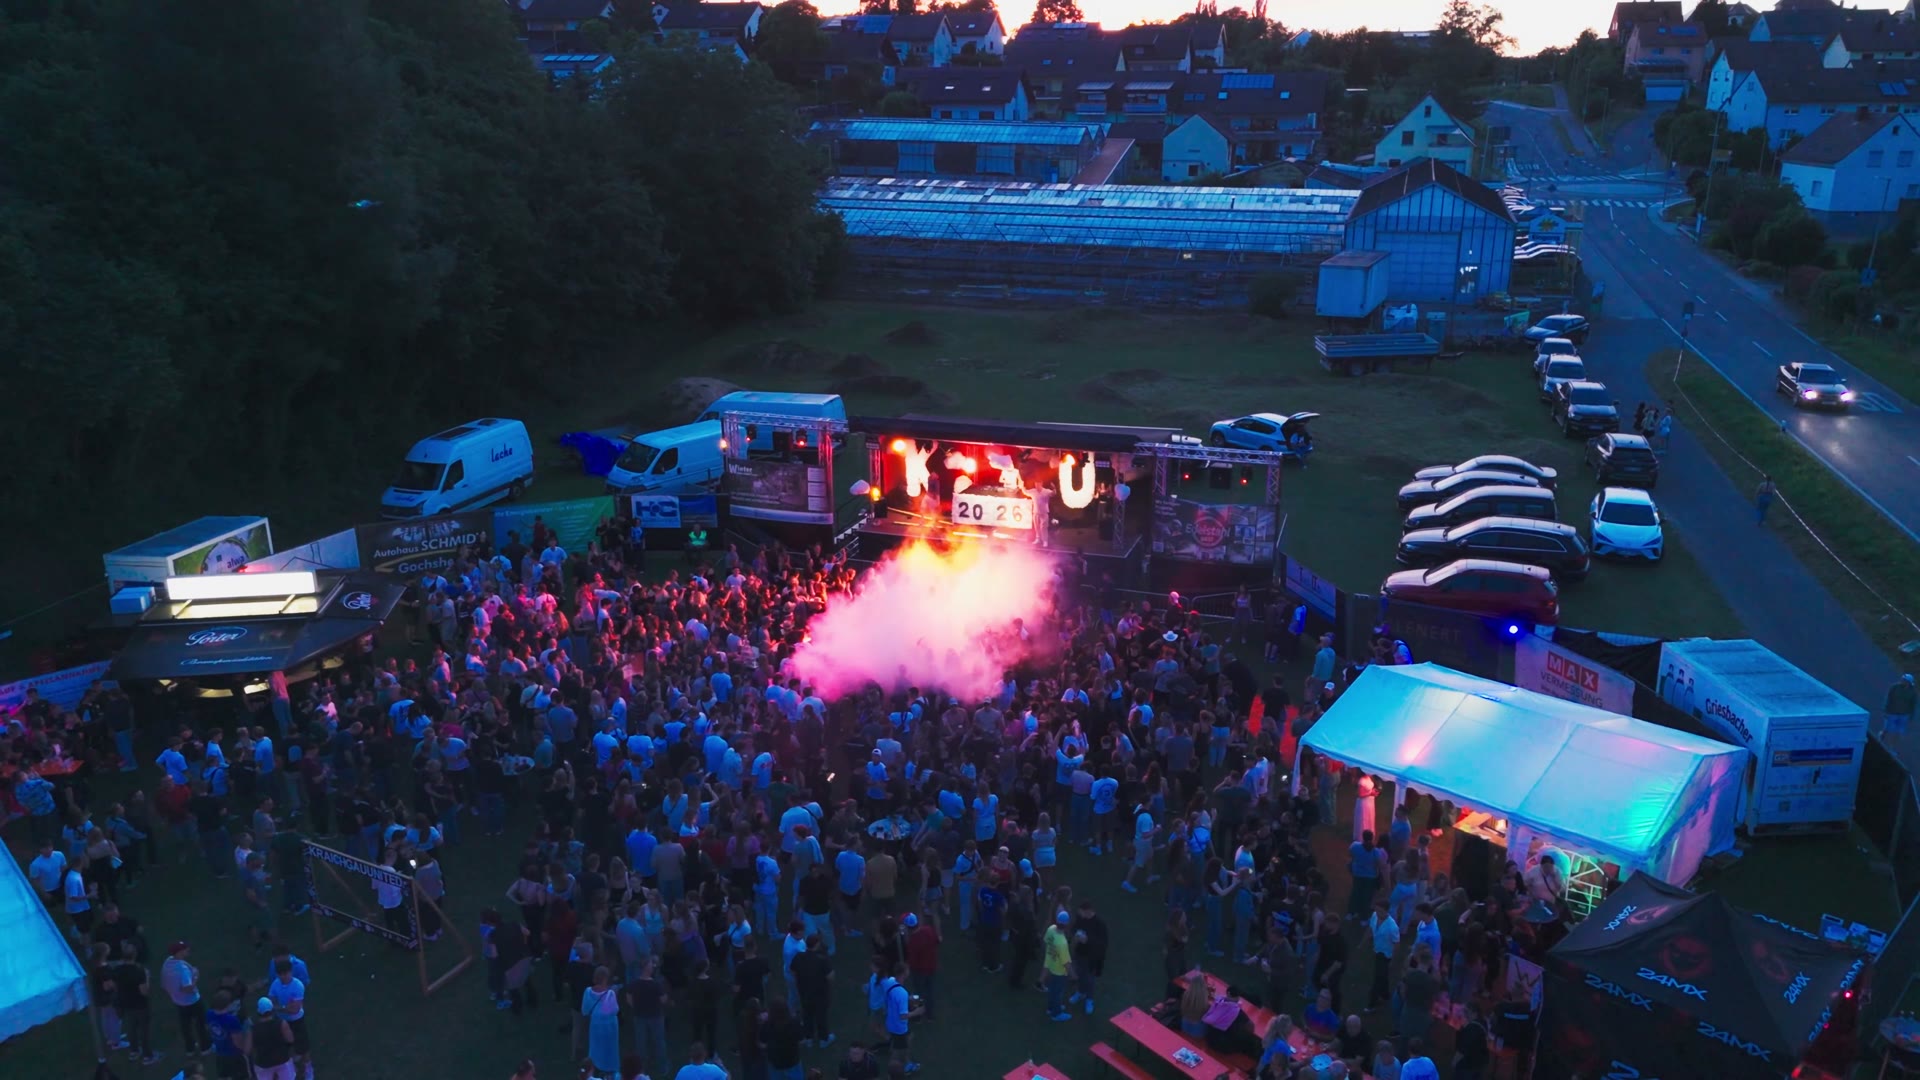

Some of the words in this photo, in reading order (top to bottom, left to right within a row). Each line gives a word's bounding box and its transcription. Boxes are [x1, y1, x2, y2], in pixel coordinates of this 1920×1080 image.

[729, 464, 753, 475] Winter
[958, 502, 984, 521] 20
[996, 503, 1024, 522] 26
[373, 546, 420, 559] Autohaus
[421, 532, 480, 551] SCHMID
[398, 556, 456, 574] Gochshe
[1540, 670, 1604, 708] VERMESSUNG
[1549, 653, 1597, 691] MAX
[1705, 698, 1753, 743] Griesbacher
[1603, 905, 1637, 931] 24MX
[1585, 972, 1653, 1012] 24MX
[1636, 967, 1708, 1001] 24MX
[1783, 971, 1812, 1005] 24MX
[1696, 1020, 1771, 1062] 24MX
